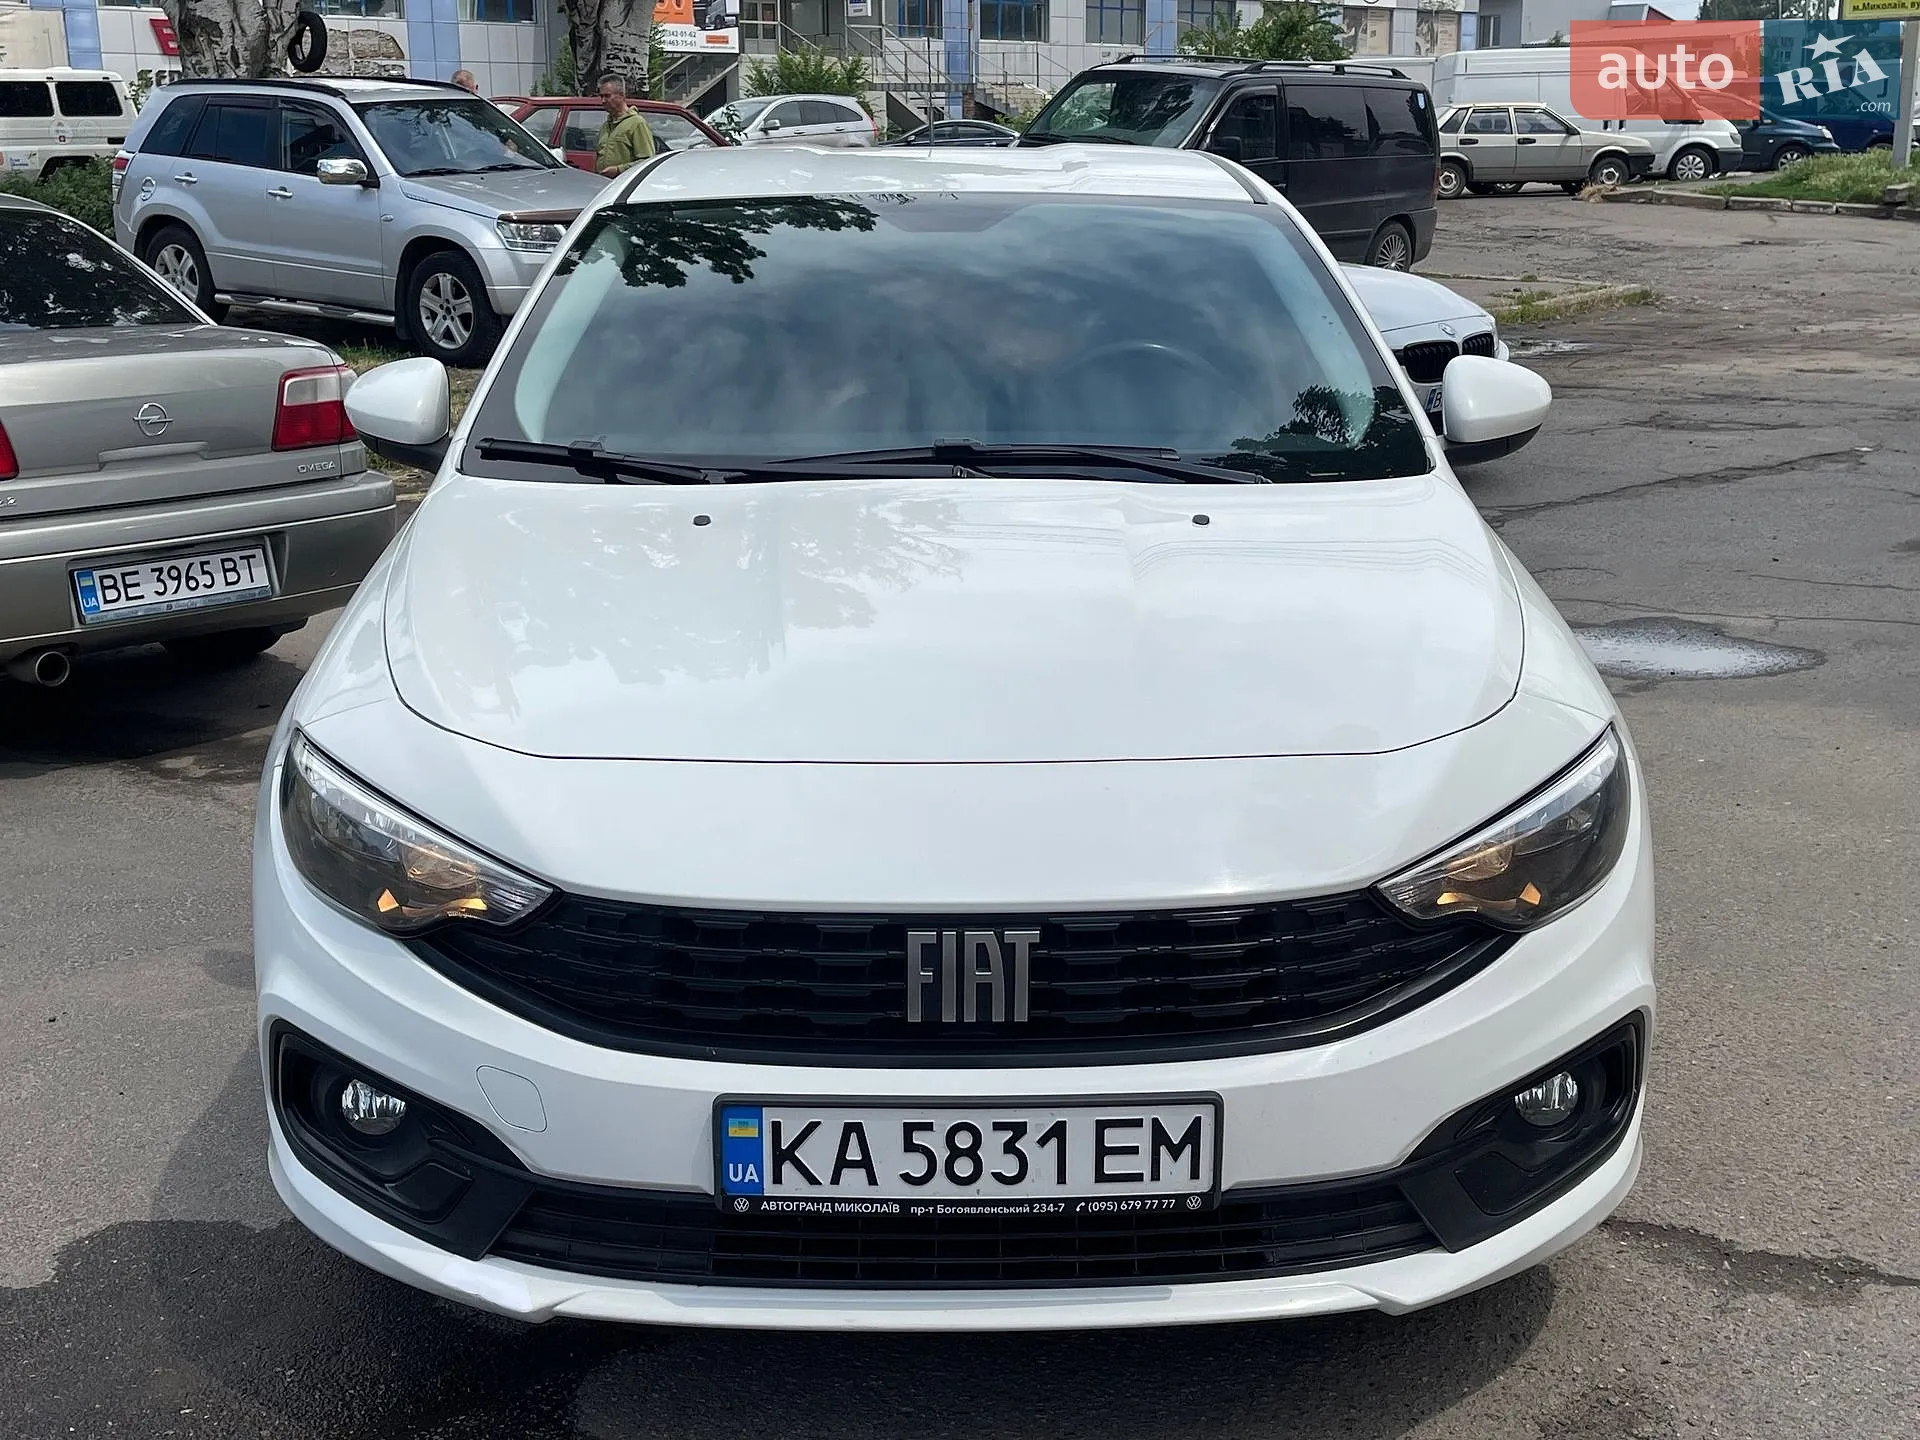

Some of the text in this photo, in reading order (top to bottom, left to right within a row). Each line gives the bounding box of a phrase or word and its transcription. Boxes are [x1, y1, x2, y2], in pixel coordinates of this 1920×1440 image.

[1433, 392, 1443, 408] B
[297, 461, 336, 473] OMEGA
[99, 570, 145, 605] BE
[150, 560, 215, 597] 3965
[220, 554, 257, 587] BT
[83, 597, 98, 608] UA
[907, 930, 1041, 1023] FIAT
[770, 1115, 1203, 1187] KA 5831 EM
[728, 1163, 760, 1183] UA
[760, 1199, 1176, 1216] АВТОГРАНД МИКОЛАЇВ пр-т Богоявленський 234-7 (095) 679 77 77
